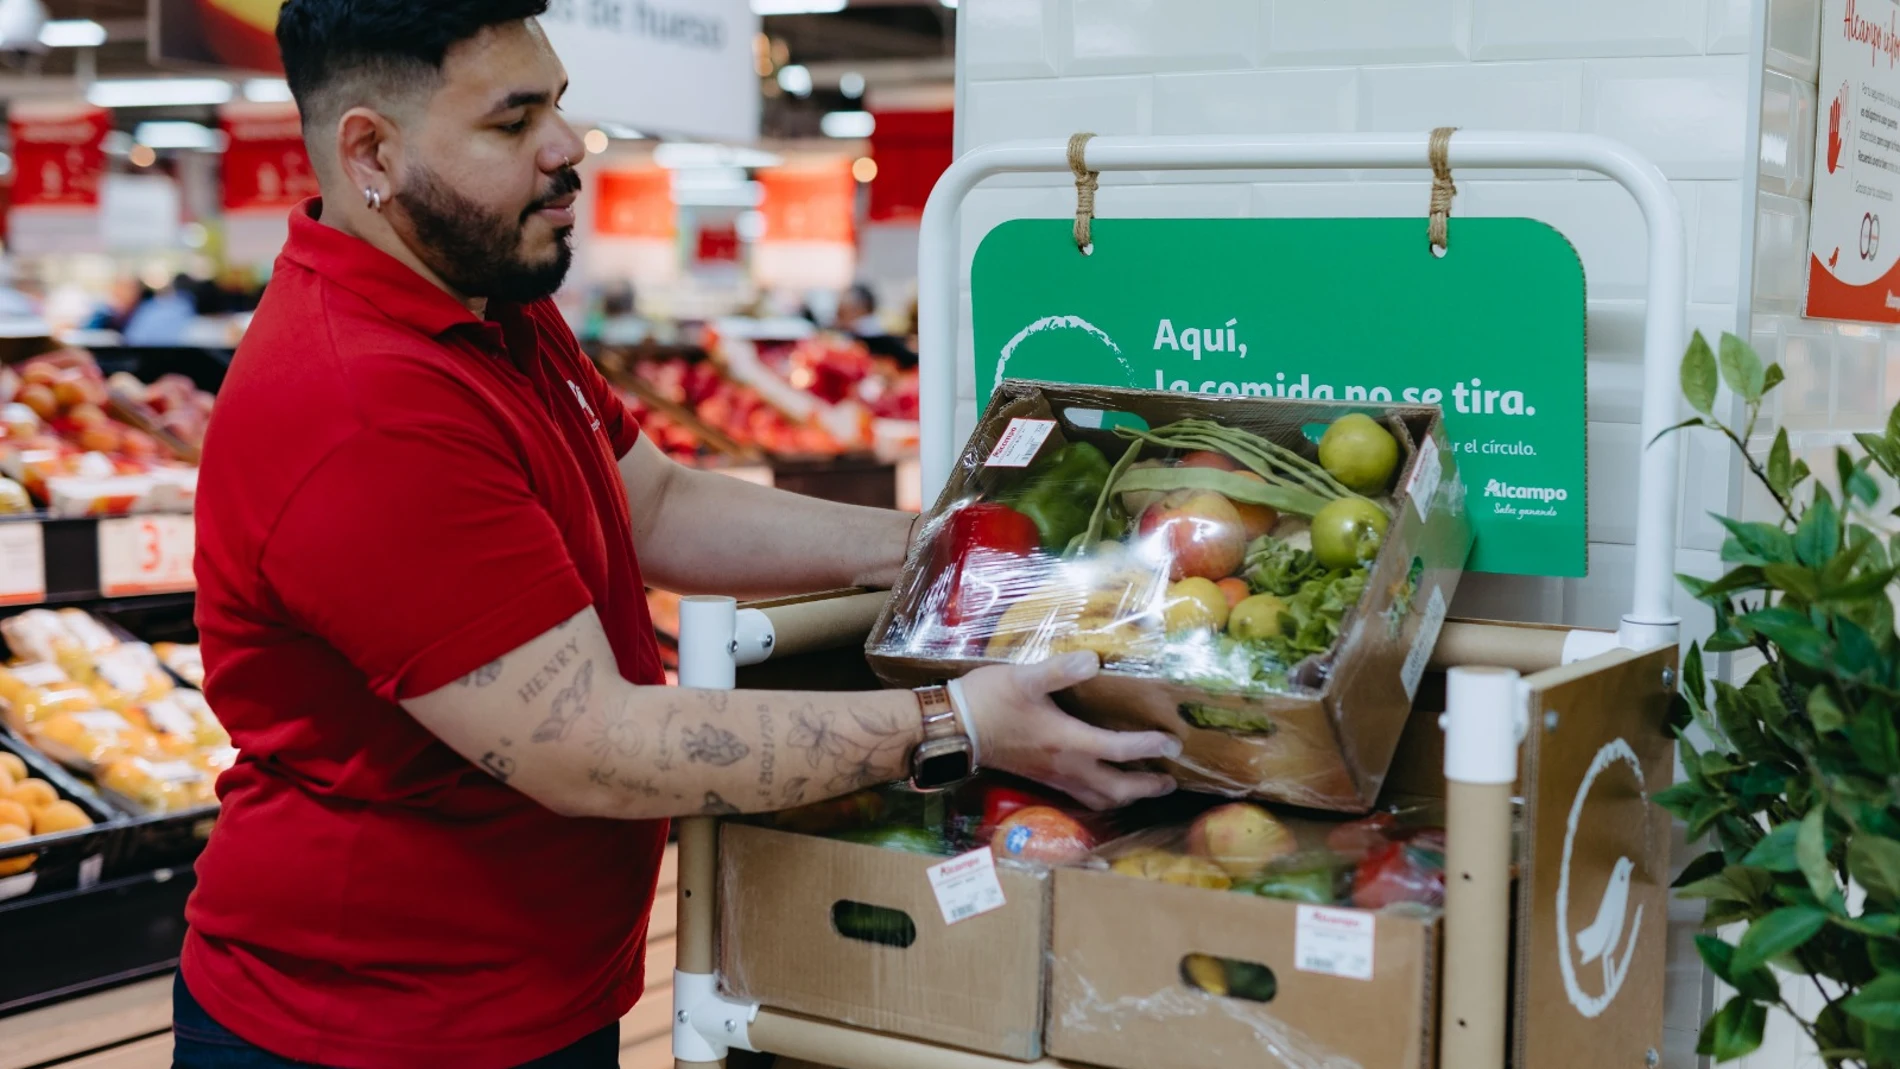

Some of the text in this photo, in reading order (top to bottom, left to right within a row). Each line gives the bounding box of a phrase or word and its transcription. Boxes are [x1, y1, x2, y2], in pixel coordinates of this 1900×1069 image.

[636, 1, 727, 51] hueso
[1153, 318, 1247, 360] Aquí,
[1345, 385, 1392, 402] no
[1403, 387, 1443, 404] se
[1452, 378, 1536, 416] tira.
[1464, 439, 1478, 453] el
[1482, 440, 1537, 456] círculo.
[1484, 478, 1567, 503] Alcampo
[1517, 505, 1557, 520] ganando
[141, 519, 162, 573] 3
[518, 637, 581, 704] HENRY
